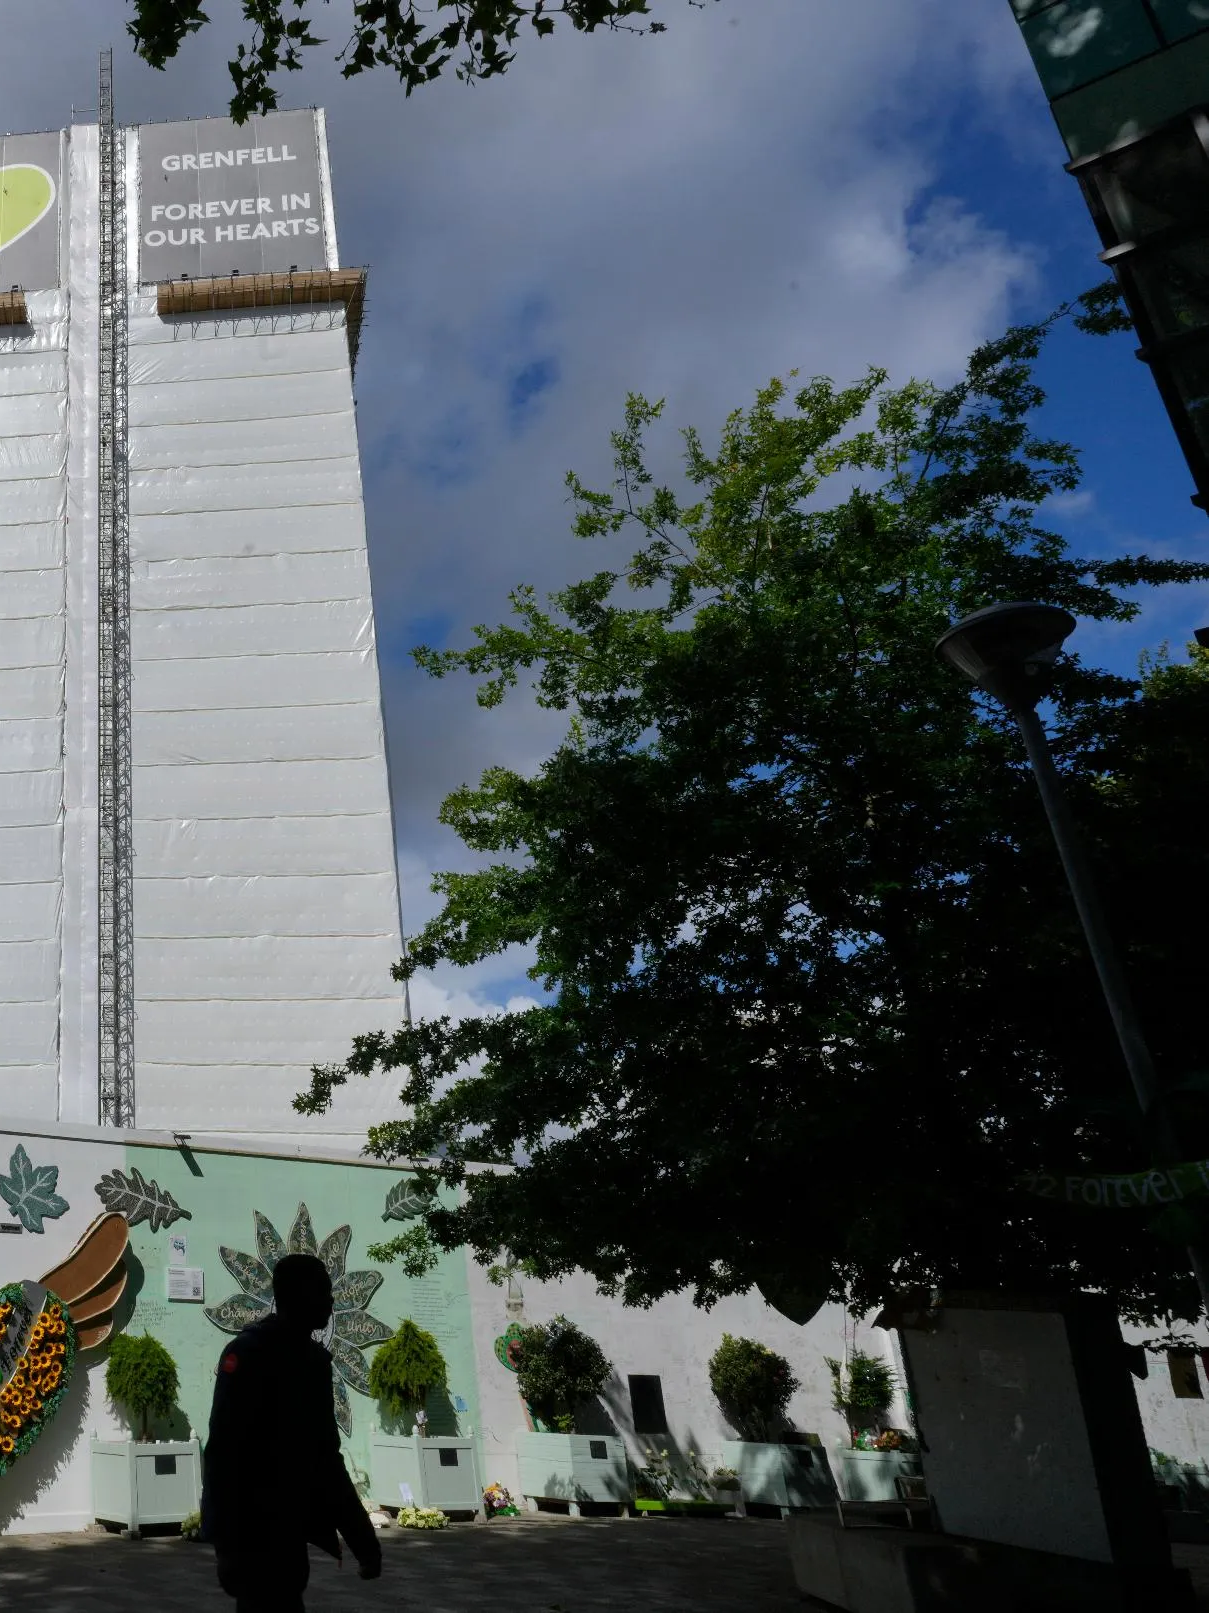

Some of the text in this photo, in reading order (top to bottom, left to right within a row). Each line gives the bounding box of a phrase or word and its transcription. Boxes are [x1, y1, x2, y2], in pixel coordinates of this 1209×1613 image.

[161, 145, 297, 172] GRENFELL
[150, 192, 311, 222] FOREVER IN
[144, 217, 320, 247] OUR HEARTS
[220, 1307, 263, 1321] Change
